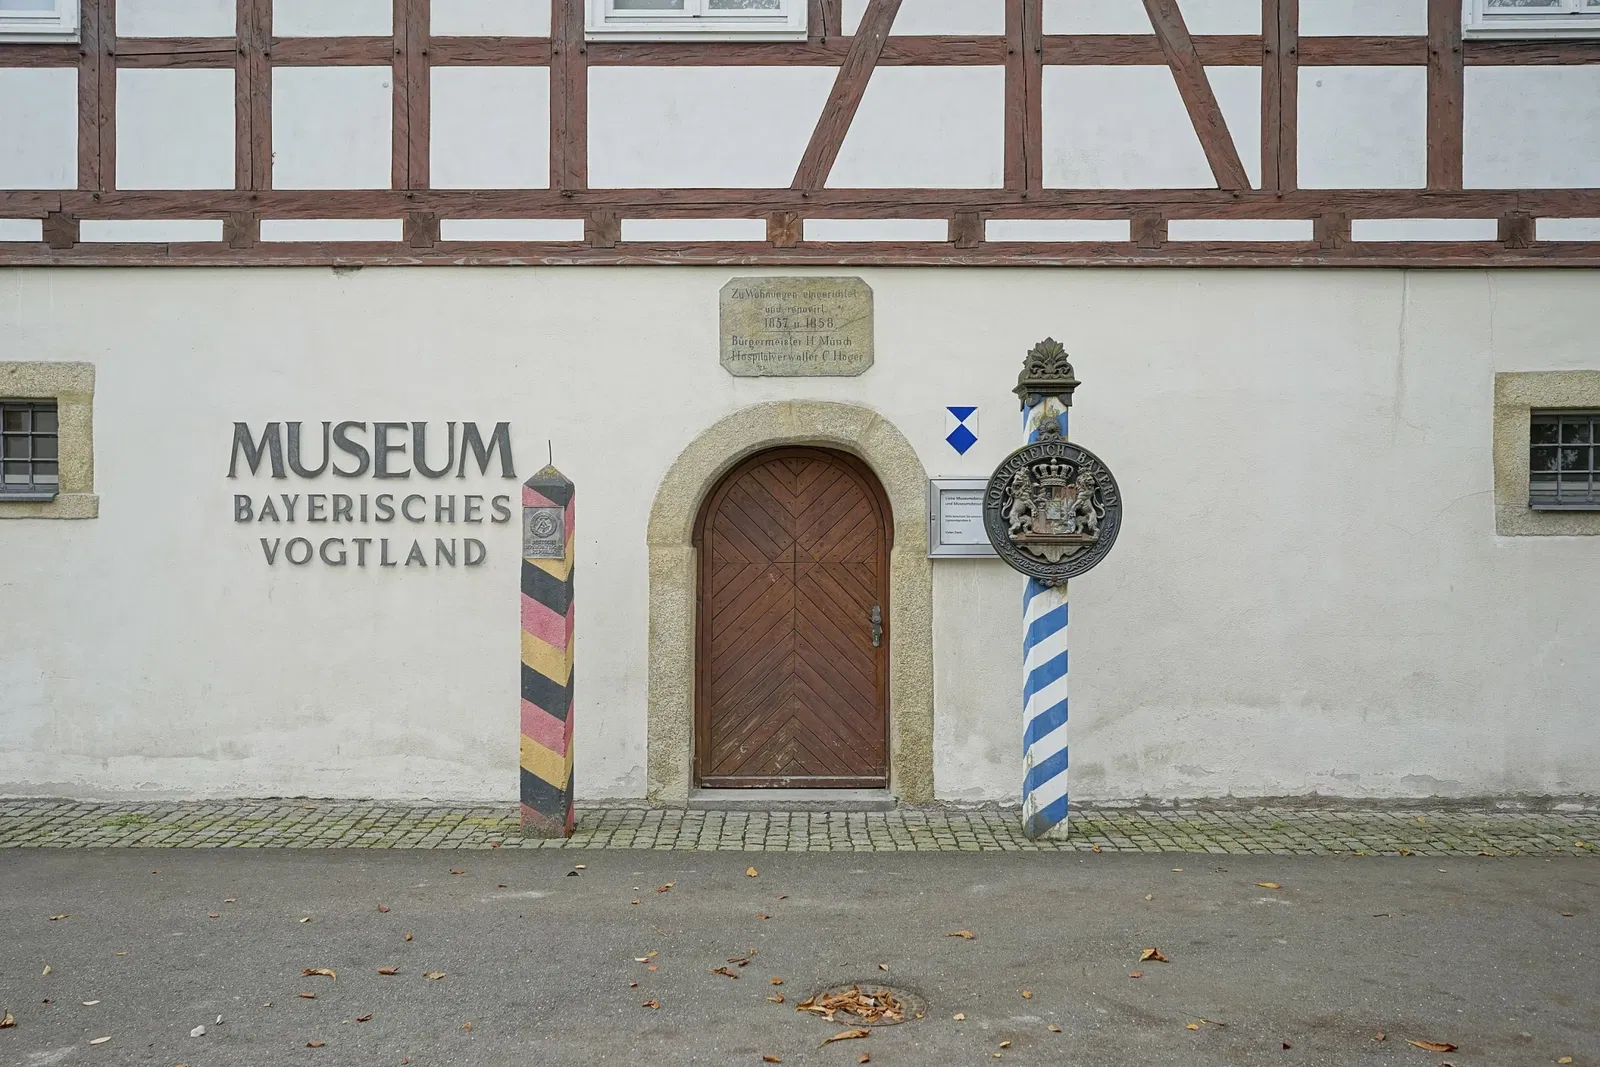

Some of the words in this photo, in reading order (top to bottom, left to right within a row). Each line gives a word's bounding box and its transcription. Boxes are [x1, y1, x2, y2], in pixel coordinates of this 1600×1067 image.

[745, 288, 798, 301] Wohnungen
[765, 304, 781, 314] und
[765, 317, 788, 328] 1857
[226, 420, 517, 479] MUSEUM
[987, 444, 1065, 509] KOENIGREICH
[1077, 451, 1118, 508] BAYERN
[233, 493, 512, 523] BAYERISCHES
[259, 536, 487, 567] VOGTLAND
